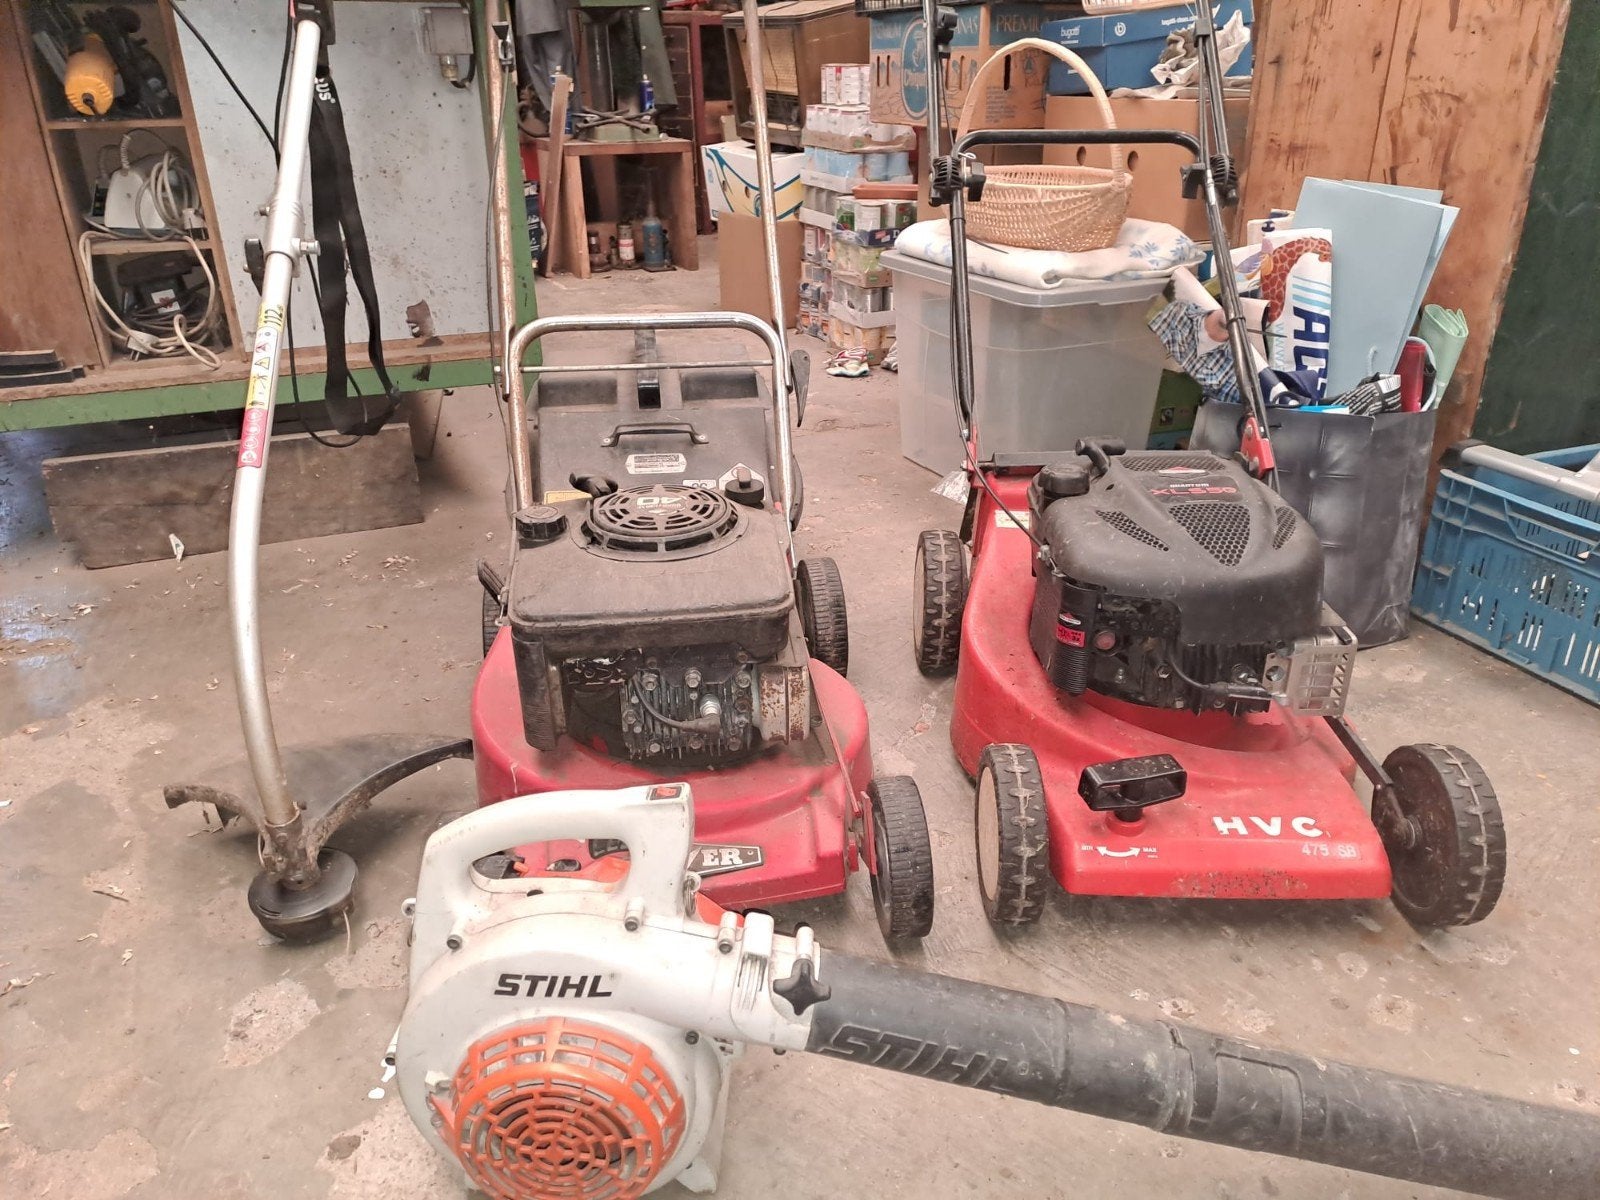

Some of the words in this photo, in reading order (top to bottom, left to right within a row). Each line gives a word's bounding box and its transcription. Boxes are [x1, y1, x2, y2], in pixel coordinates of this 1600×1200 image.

[1212, 816, 1324, 838] HVC
[1301, 843, 1330, 856] 475
[1338, 845, 1357, 858] SB
[494, 973, 612, 998] STIHL
[817, 1023, 1014, 1093] STIHL
